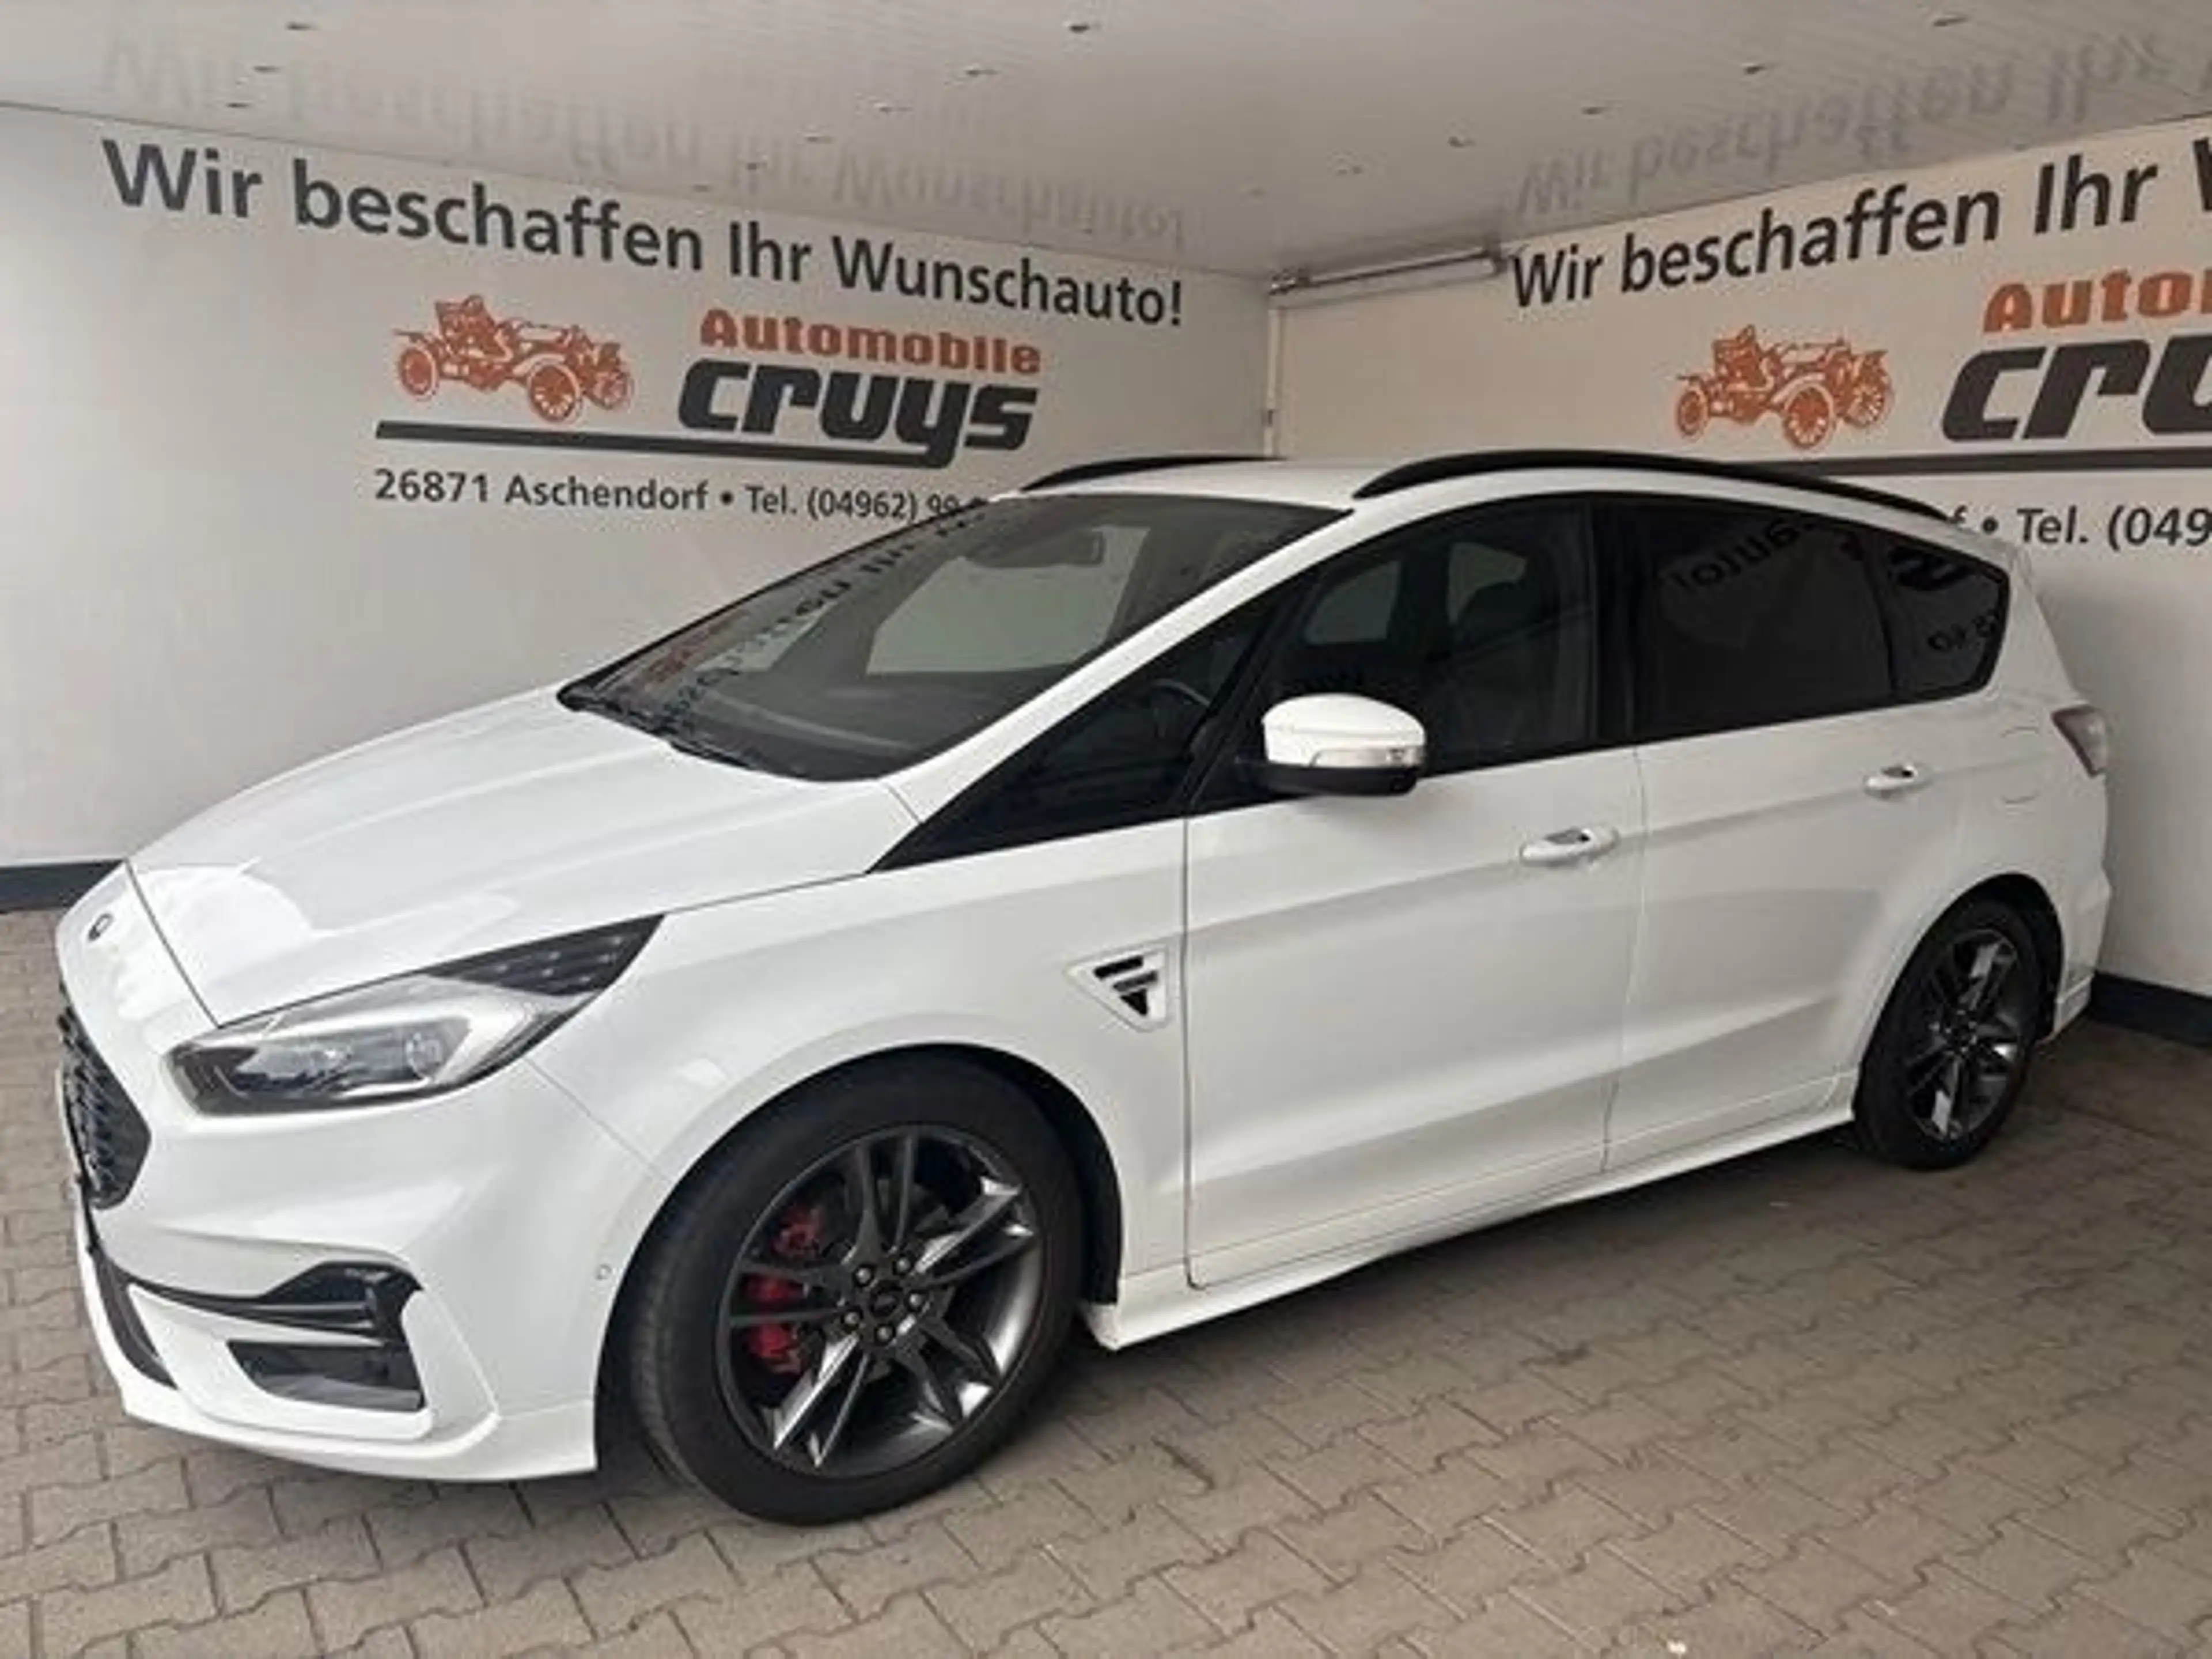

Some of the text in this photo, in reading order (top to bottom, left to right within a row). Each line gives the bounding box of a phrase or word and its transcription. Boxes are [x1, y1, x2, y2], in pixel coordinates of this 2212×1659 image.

[102, 139, 1181, 326] Wir beschaffen Ihr Wunschauto!
[1512, 244, 1604, 308] Wir
[1620, 184, 1999, 293] beschaffen
[2035, 153, 2158, 234] Ihr
[700, 308, 1040, 374] Automobile
[678, 359, 1039, 468] cruys
[375, 468, 488, 502] 26871
[504, 475, 709, 510] Aschendorf
[744, 485, 798, 514] Tel.
[806, 487, 918, 520] (04962)
[2017, 505, 2212, 551] Tel. (049
